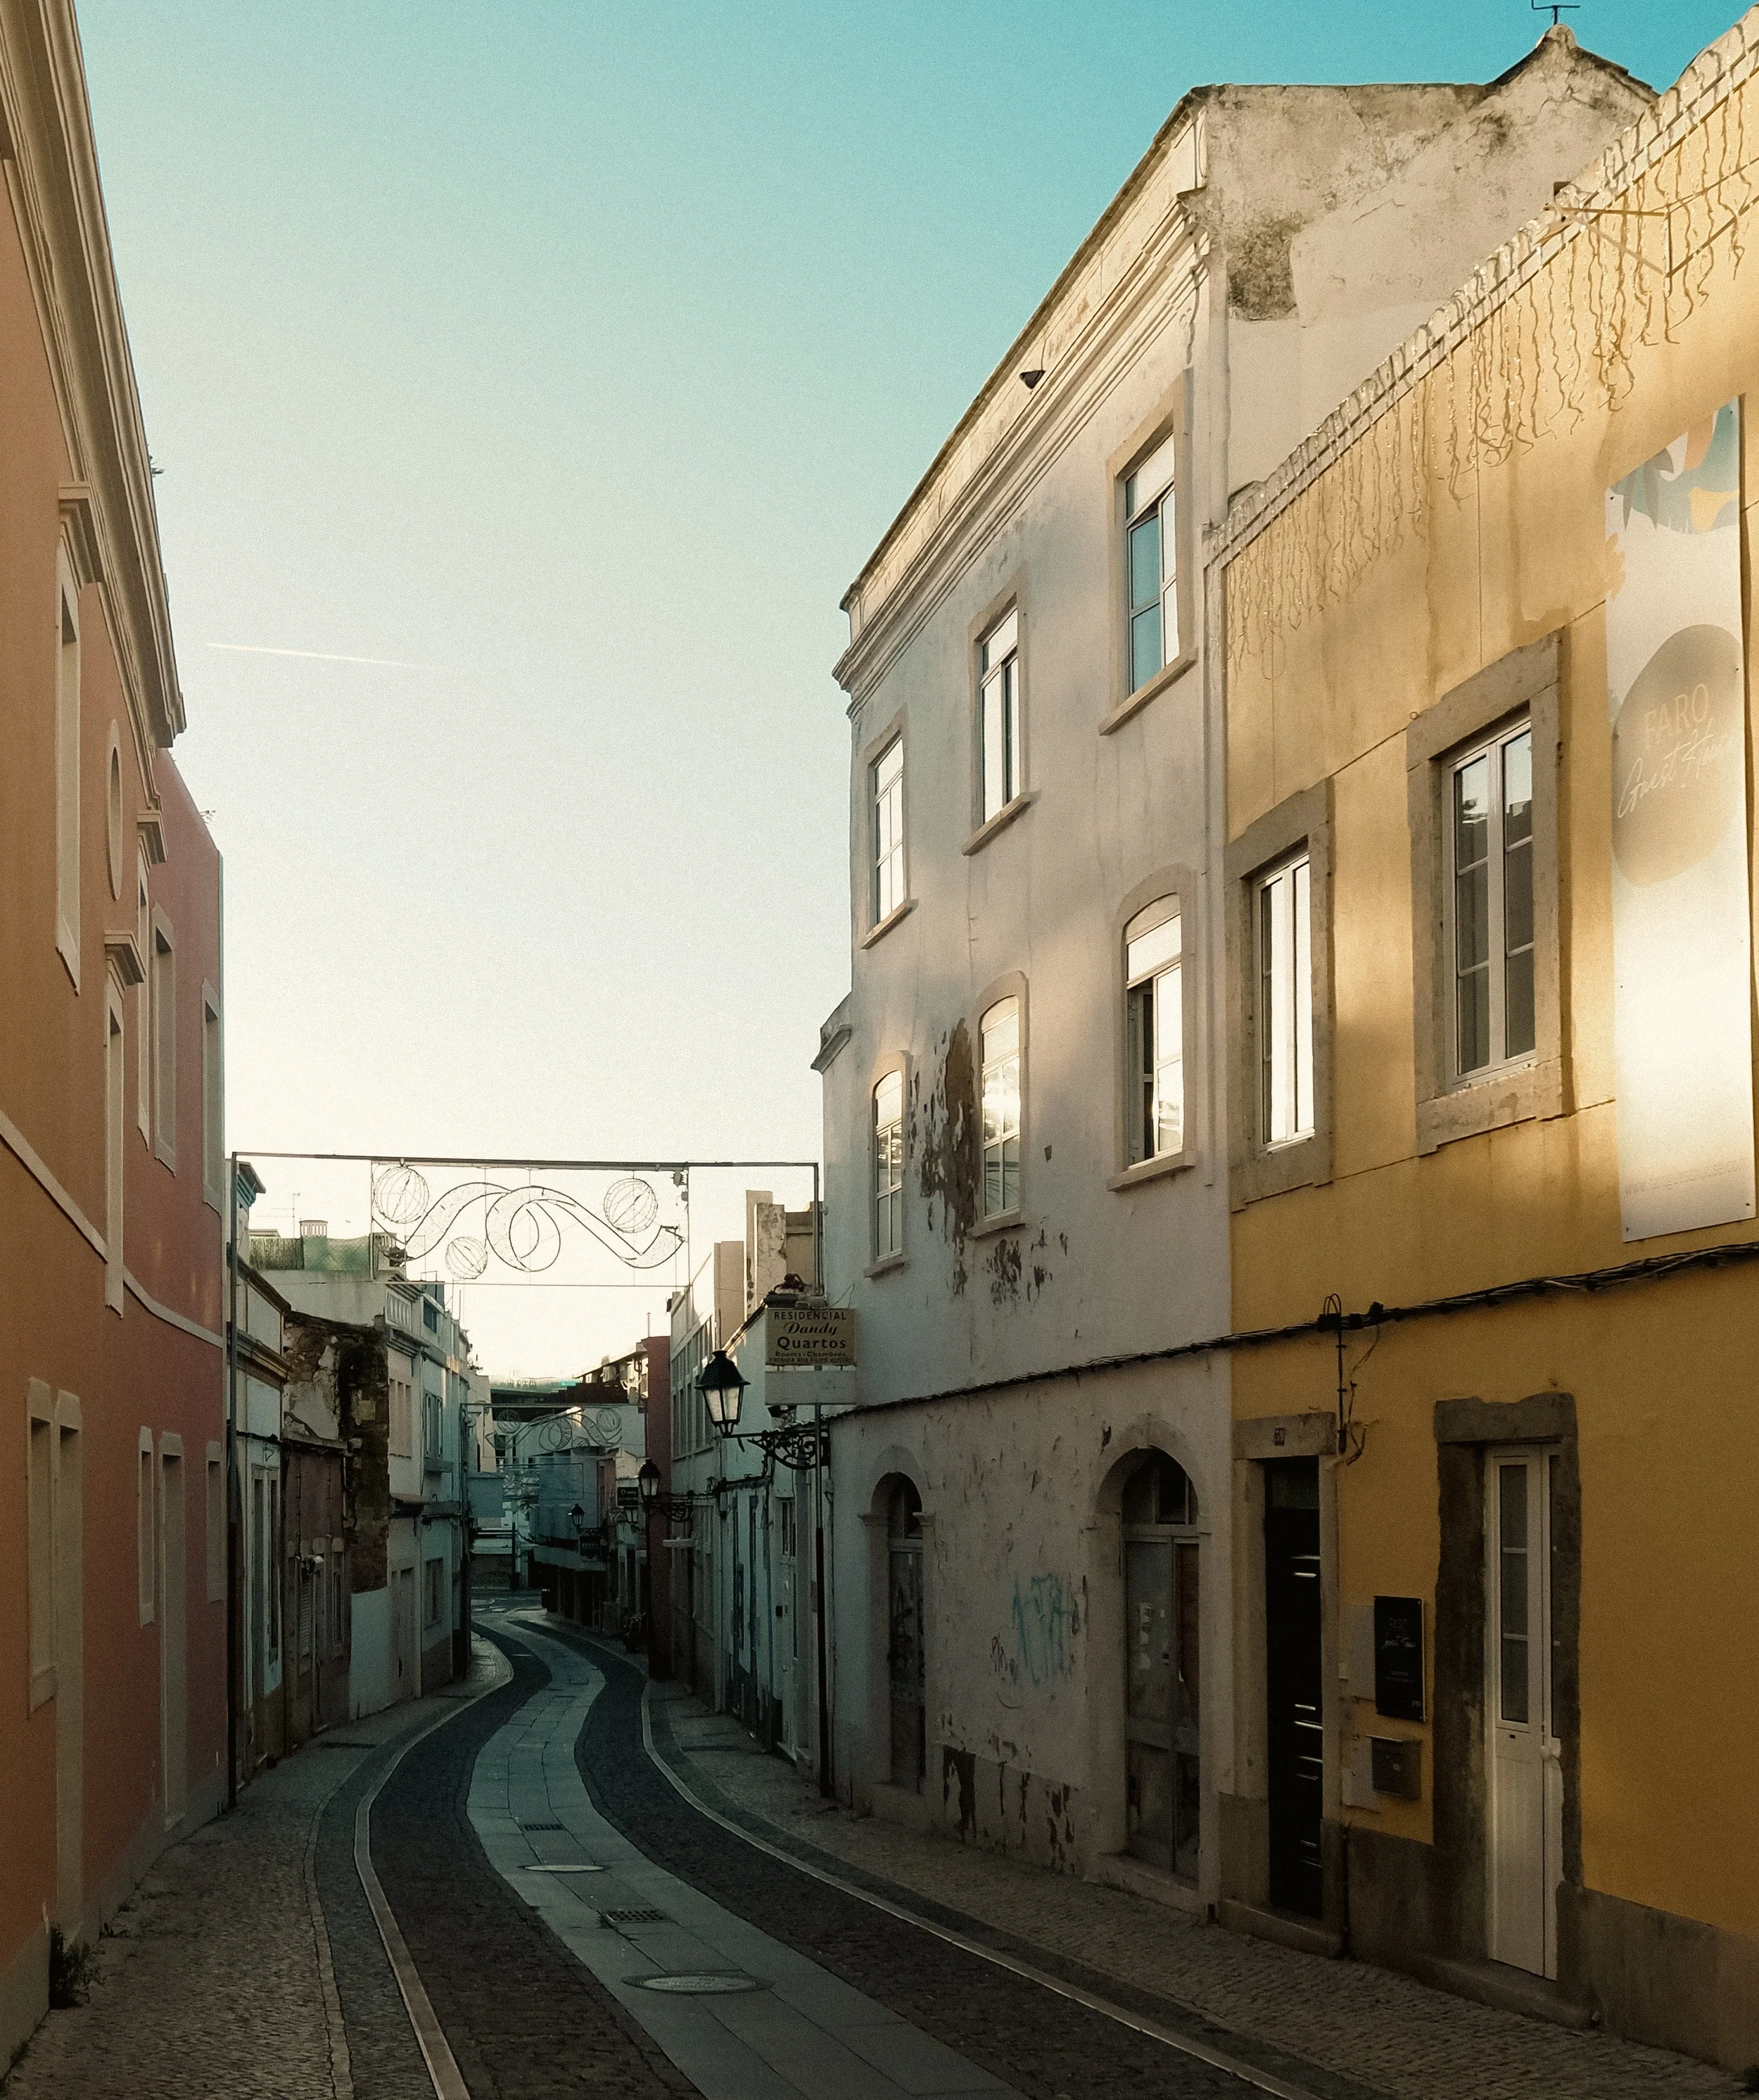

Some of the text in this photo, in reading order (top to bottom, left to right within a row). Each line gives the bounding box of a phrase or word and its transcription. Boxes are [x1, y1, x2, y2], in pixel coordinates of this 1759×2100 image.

[1644, 683, 1709, 751] FARO
[774, 1311, 847, 1320] RESIDENCIAL
[783, 1322, 838, 1336] Dandy
[777, 1336, 846, 1351] Quartos
